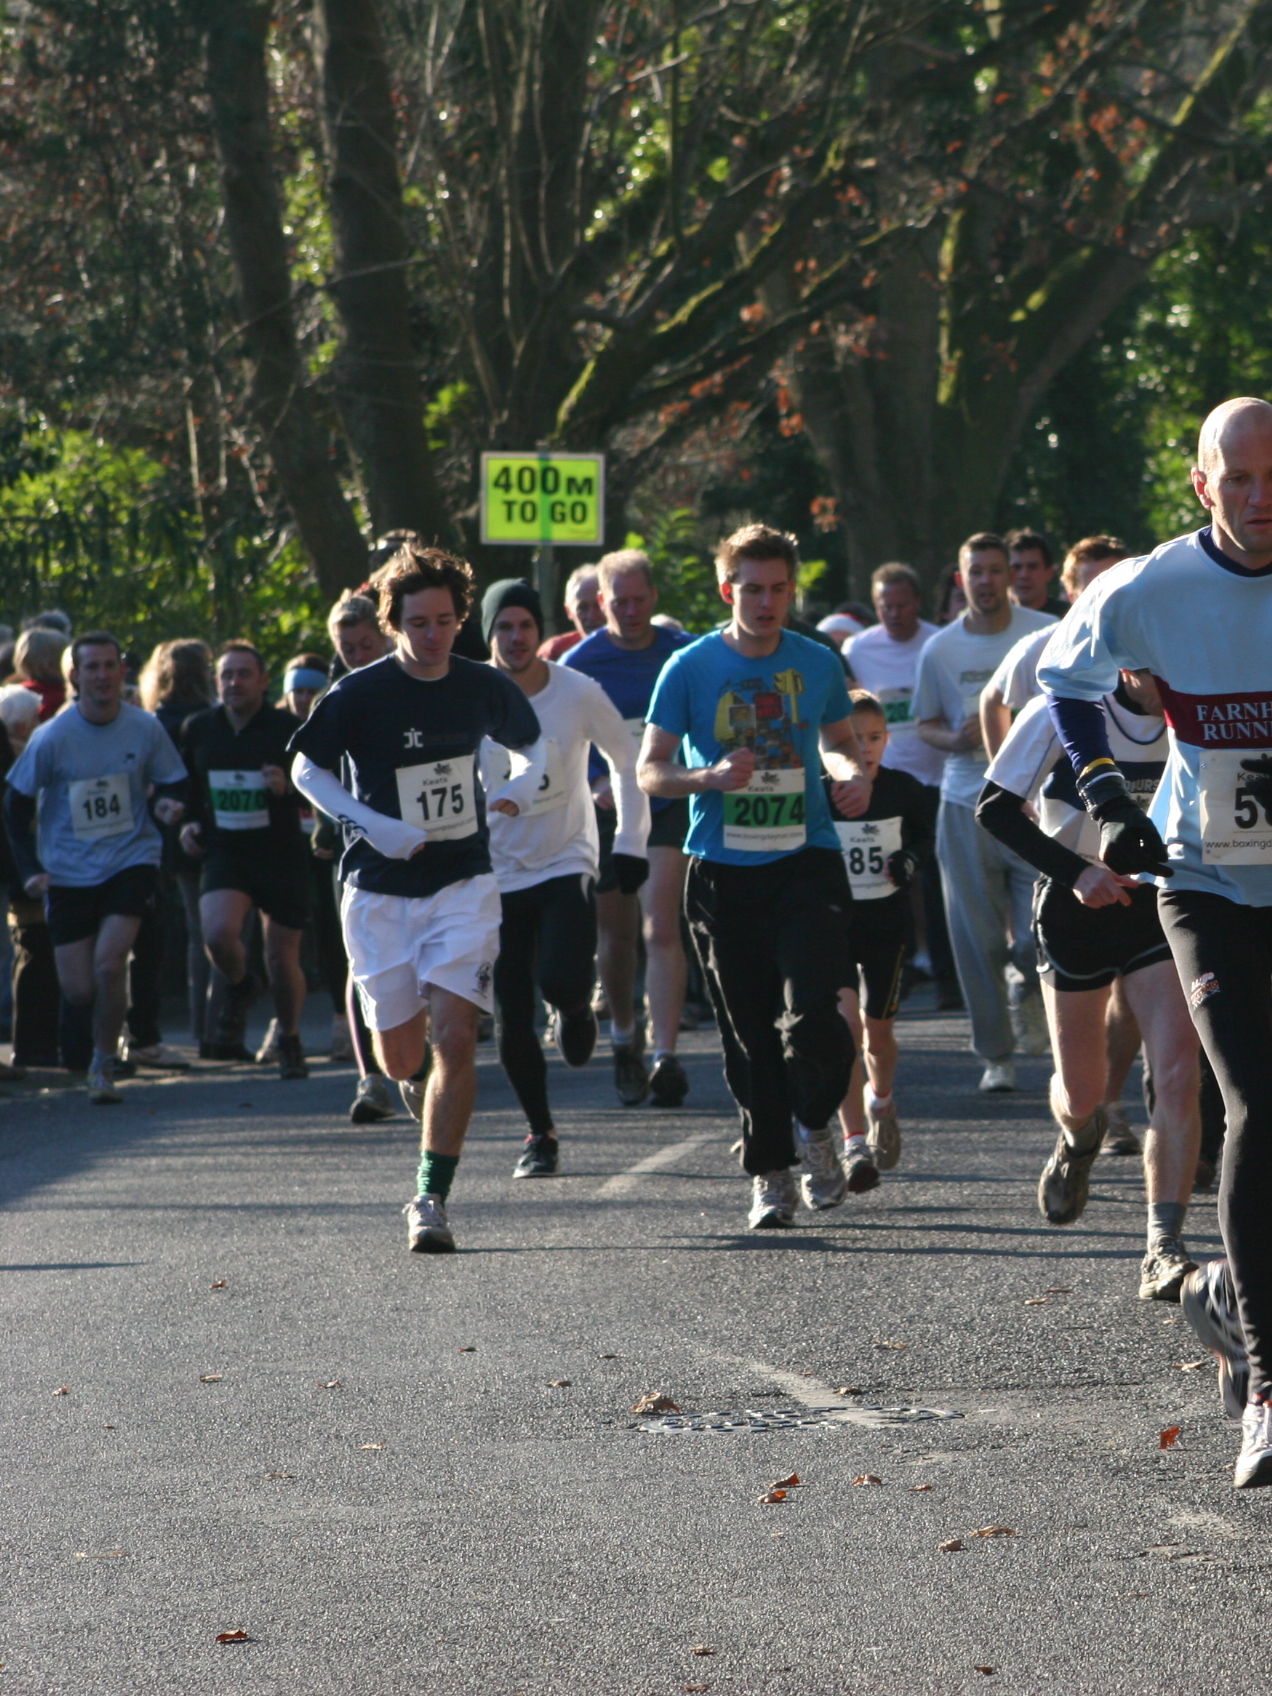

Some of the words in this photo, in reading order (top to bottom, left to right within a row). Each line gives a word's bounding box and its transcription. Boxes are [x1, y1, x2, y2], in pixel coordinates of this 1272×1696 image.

[503, 500, 538, 523] TO
[550, 500, 588, 524] GO
[423, 776, 448, 786] Keats
[748, 784, 775, 793] Keats
[83, 793, 121, 821] 184
[416, 783, 465, 821] 175
[734, 796, 806, 826] 2074
[850, 836, 876, 844] Keats
[849, 846, 885, 876] 85
